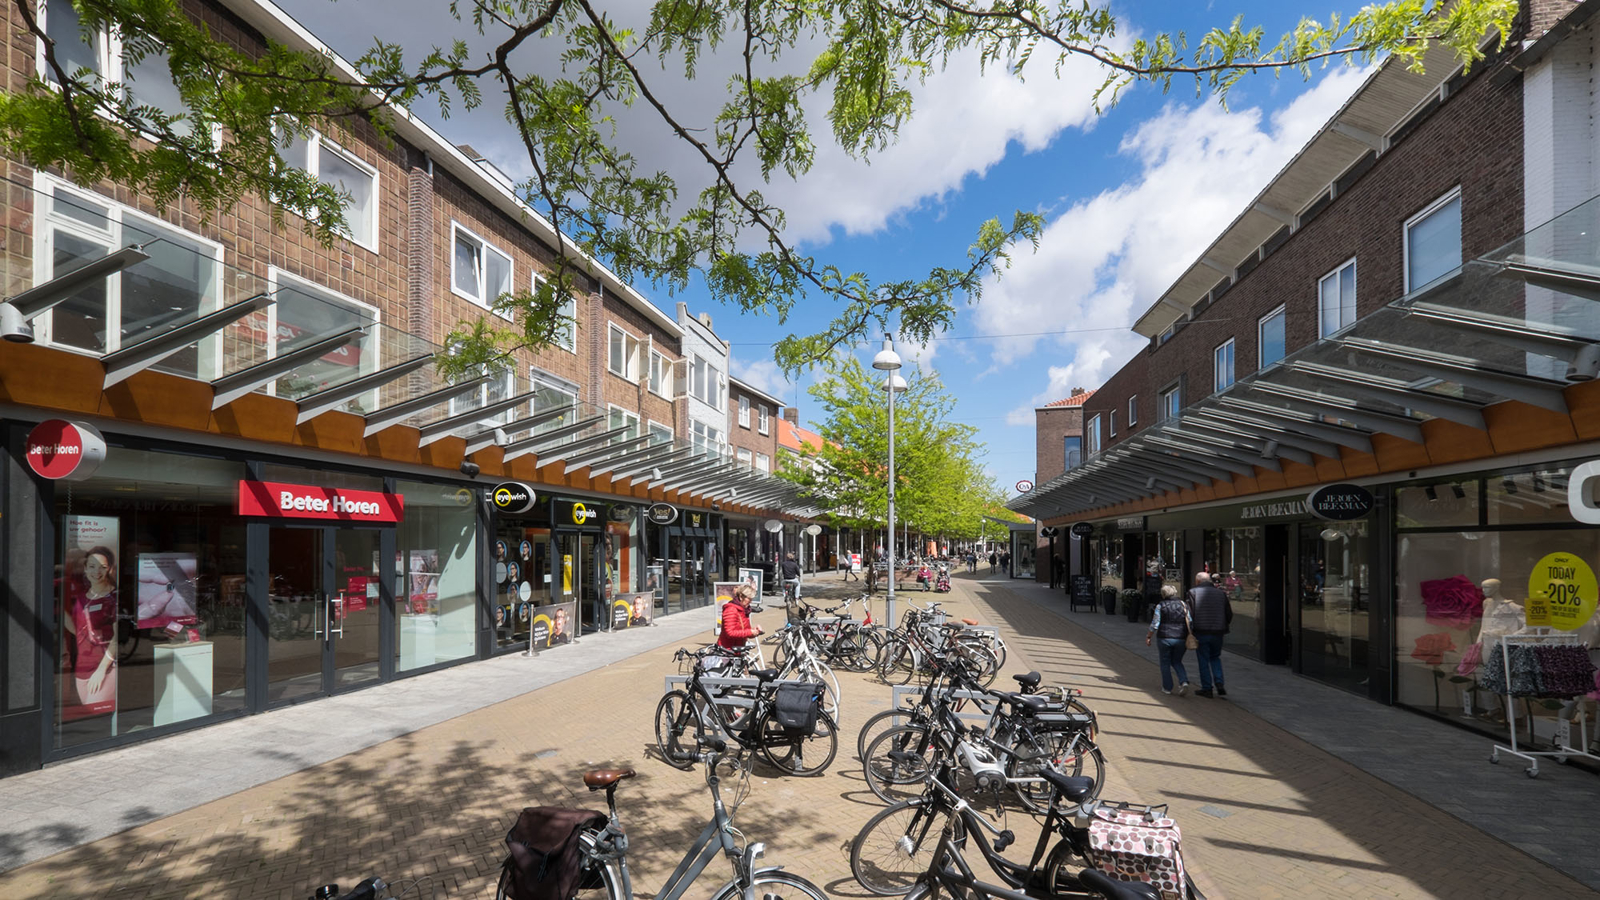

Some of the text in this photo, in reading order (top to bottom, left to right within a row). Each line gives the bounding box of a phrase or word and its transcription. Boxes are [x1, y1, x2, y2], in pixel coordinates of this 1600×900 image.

[31, 443, 79, 454] Beter Horen
[280, 491, 380, 515] Beter Horen
[1324, 494, 1361, 502] JEROEN
[1318, 502, 1368, 510] BEEKMAN
[1548, 566, 1576, 580] TODAY
[1544, 582, 1582, 606] -20%
